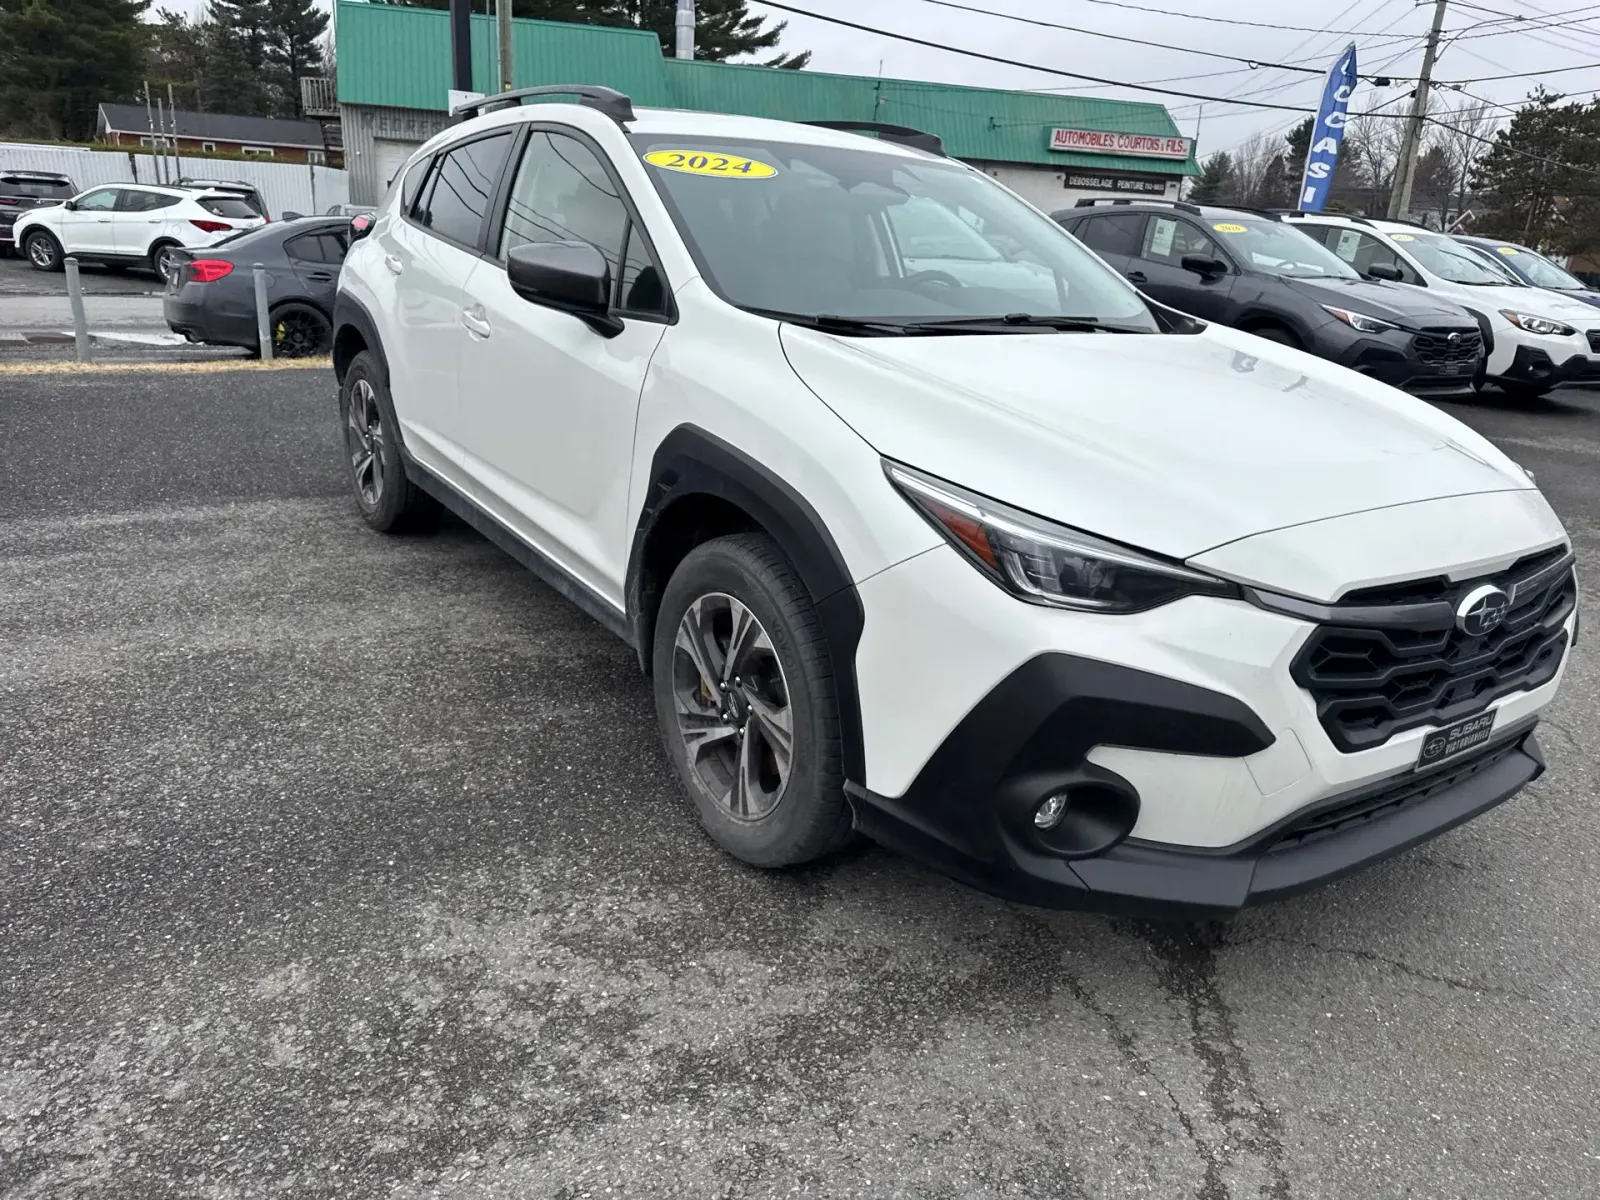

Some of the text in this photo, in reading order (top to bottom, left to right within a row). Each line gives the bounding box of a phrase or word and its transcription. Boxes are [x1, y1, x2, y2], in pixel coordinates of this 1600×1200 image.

[1054, 130, 1114, 148] AUTOMOBILES
[1117, 135, 1160, 151] COURTOIS
[1166, 139, 1184, 152] FILS
[665, 154, 753, 173] 2024
[1117, 180, 1144, 190] PEINTURE
[1449, 713, 1494, 740] SUBARU
